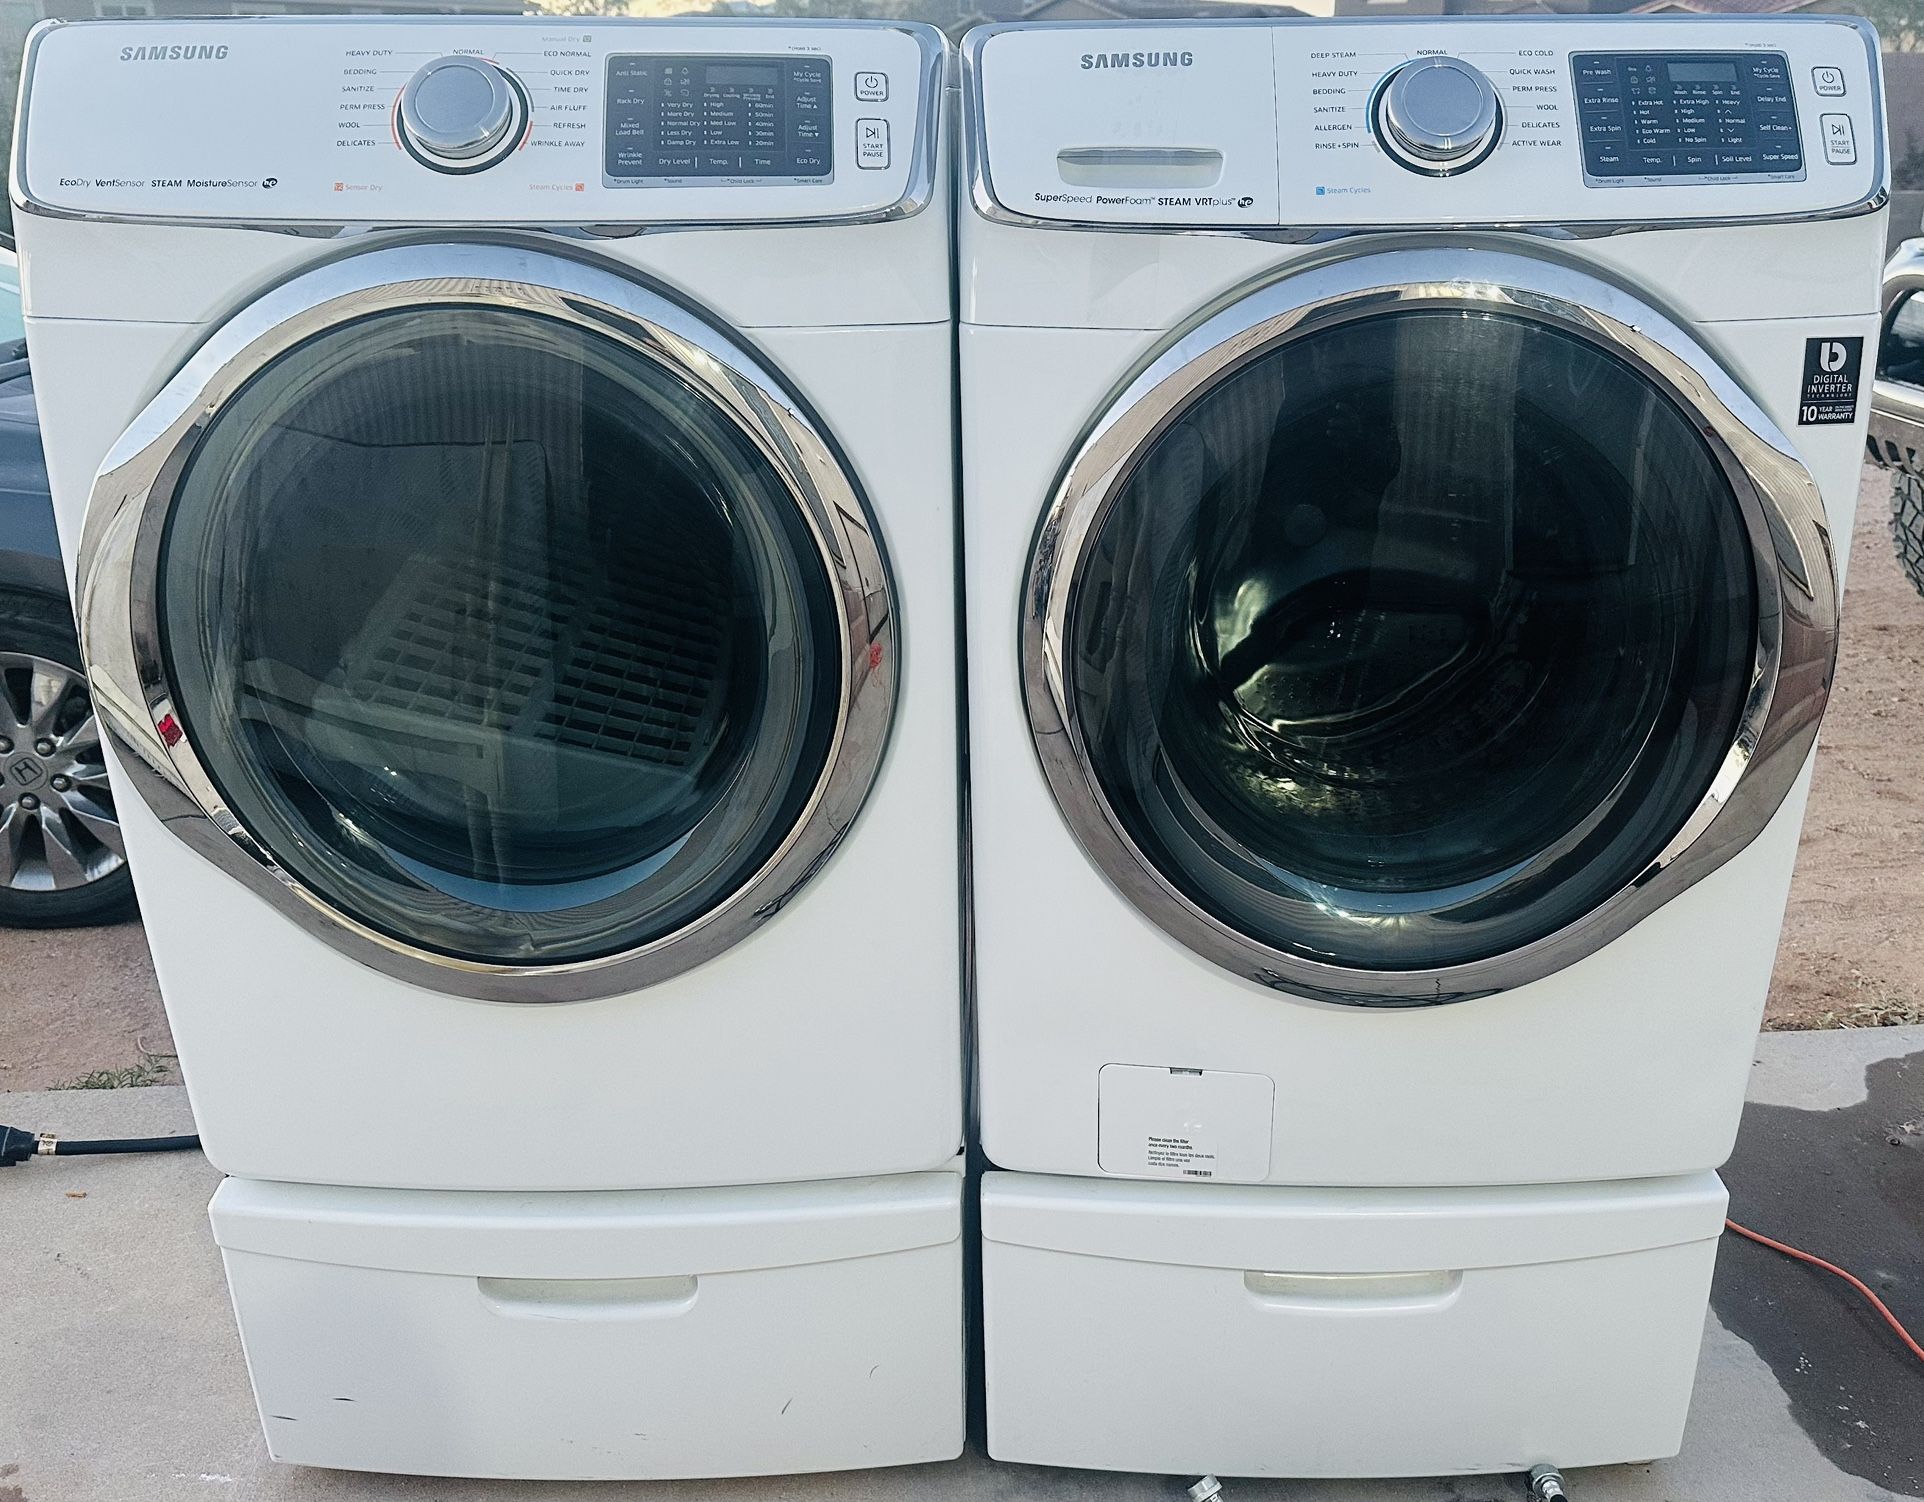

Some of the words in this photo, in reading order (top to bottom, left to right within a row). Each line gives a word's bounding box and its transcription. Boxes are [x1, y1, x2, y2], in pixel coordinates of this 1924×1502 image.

[120, 45, 229, 61] SAMSUNG
[1080, 51, 1193, 69] SAMSUNG
[797, 96, 816, 104] Adjust
[659, 158, 671, 166] Dry
[1687, 156, 1702, 164] Spin
[59, 178, 91, 188] EcoDry
[95, 178, 145, 188] VentSensor
[151, 179, 182, 188] STEAM
[186, 178, 258, 188] MoistureSensor
[370, 184, 383, 192] Dry
[551, 183, 574, 192] Cycles
[1350, 187, 1371, 195] Cycles
[1035, 192, 1093, 203] SuperSpeed
[1158, 197, 1191, 206] STEAM
[1813, 375, 1848, 383] DIGITAL
[1807, 384, 1852, 393] INVERTER
[1802, 405, 1817, 421] 10
[1818, 412, 1853, 420] WARRANTY
